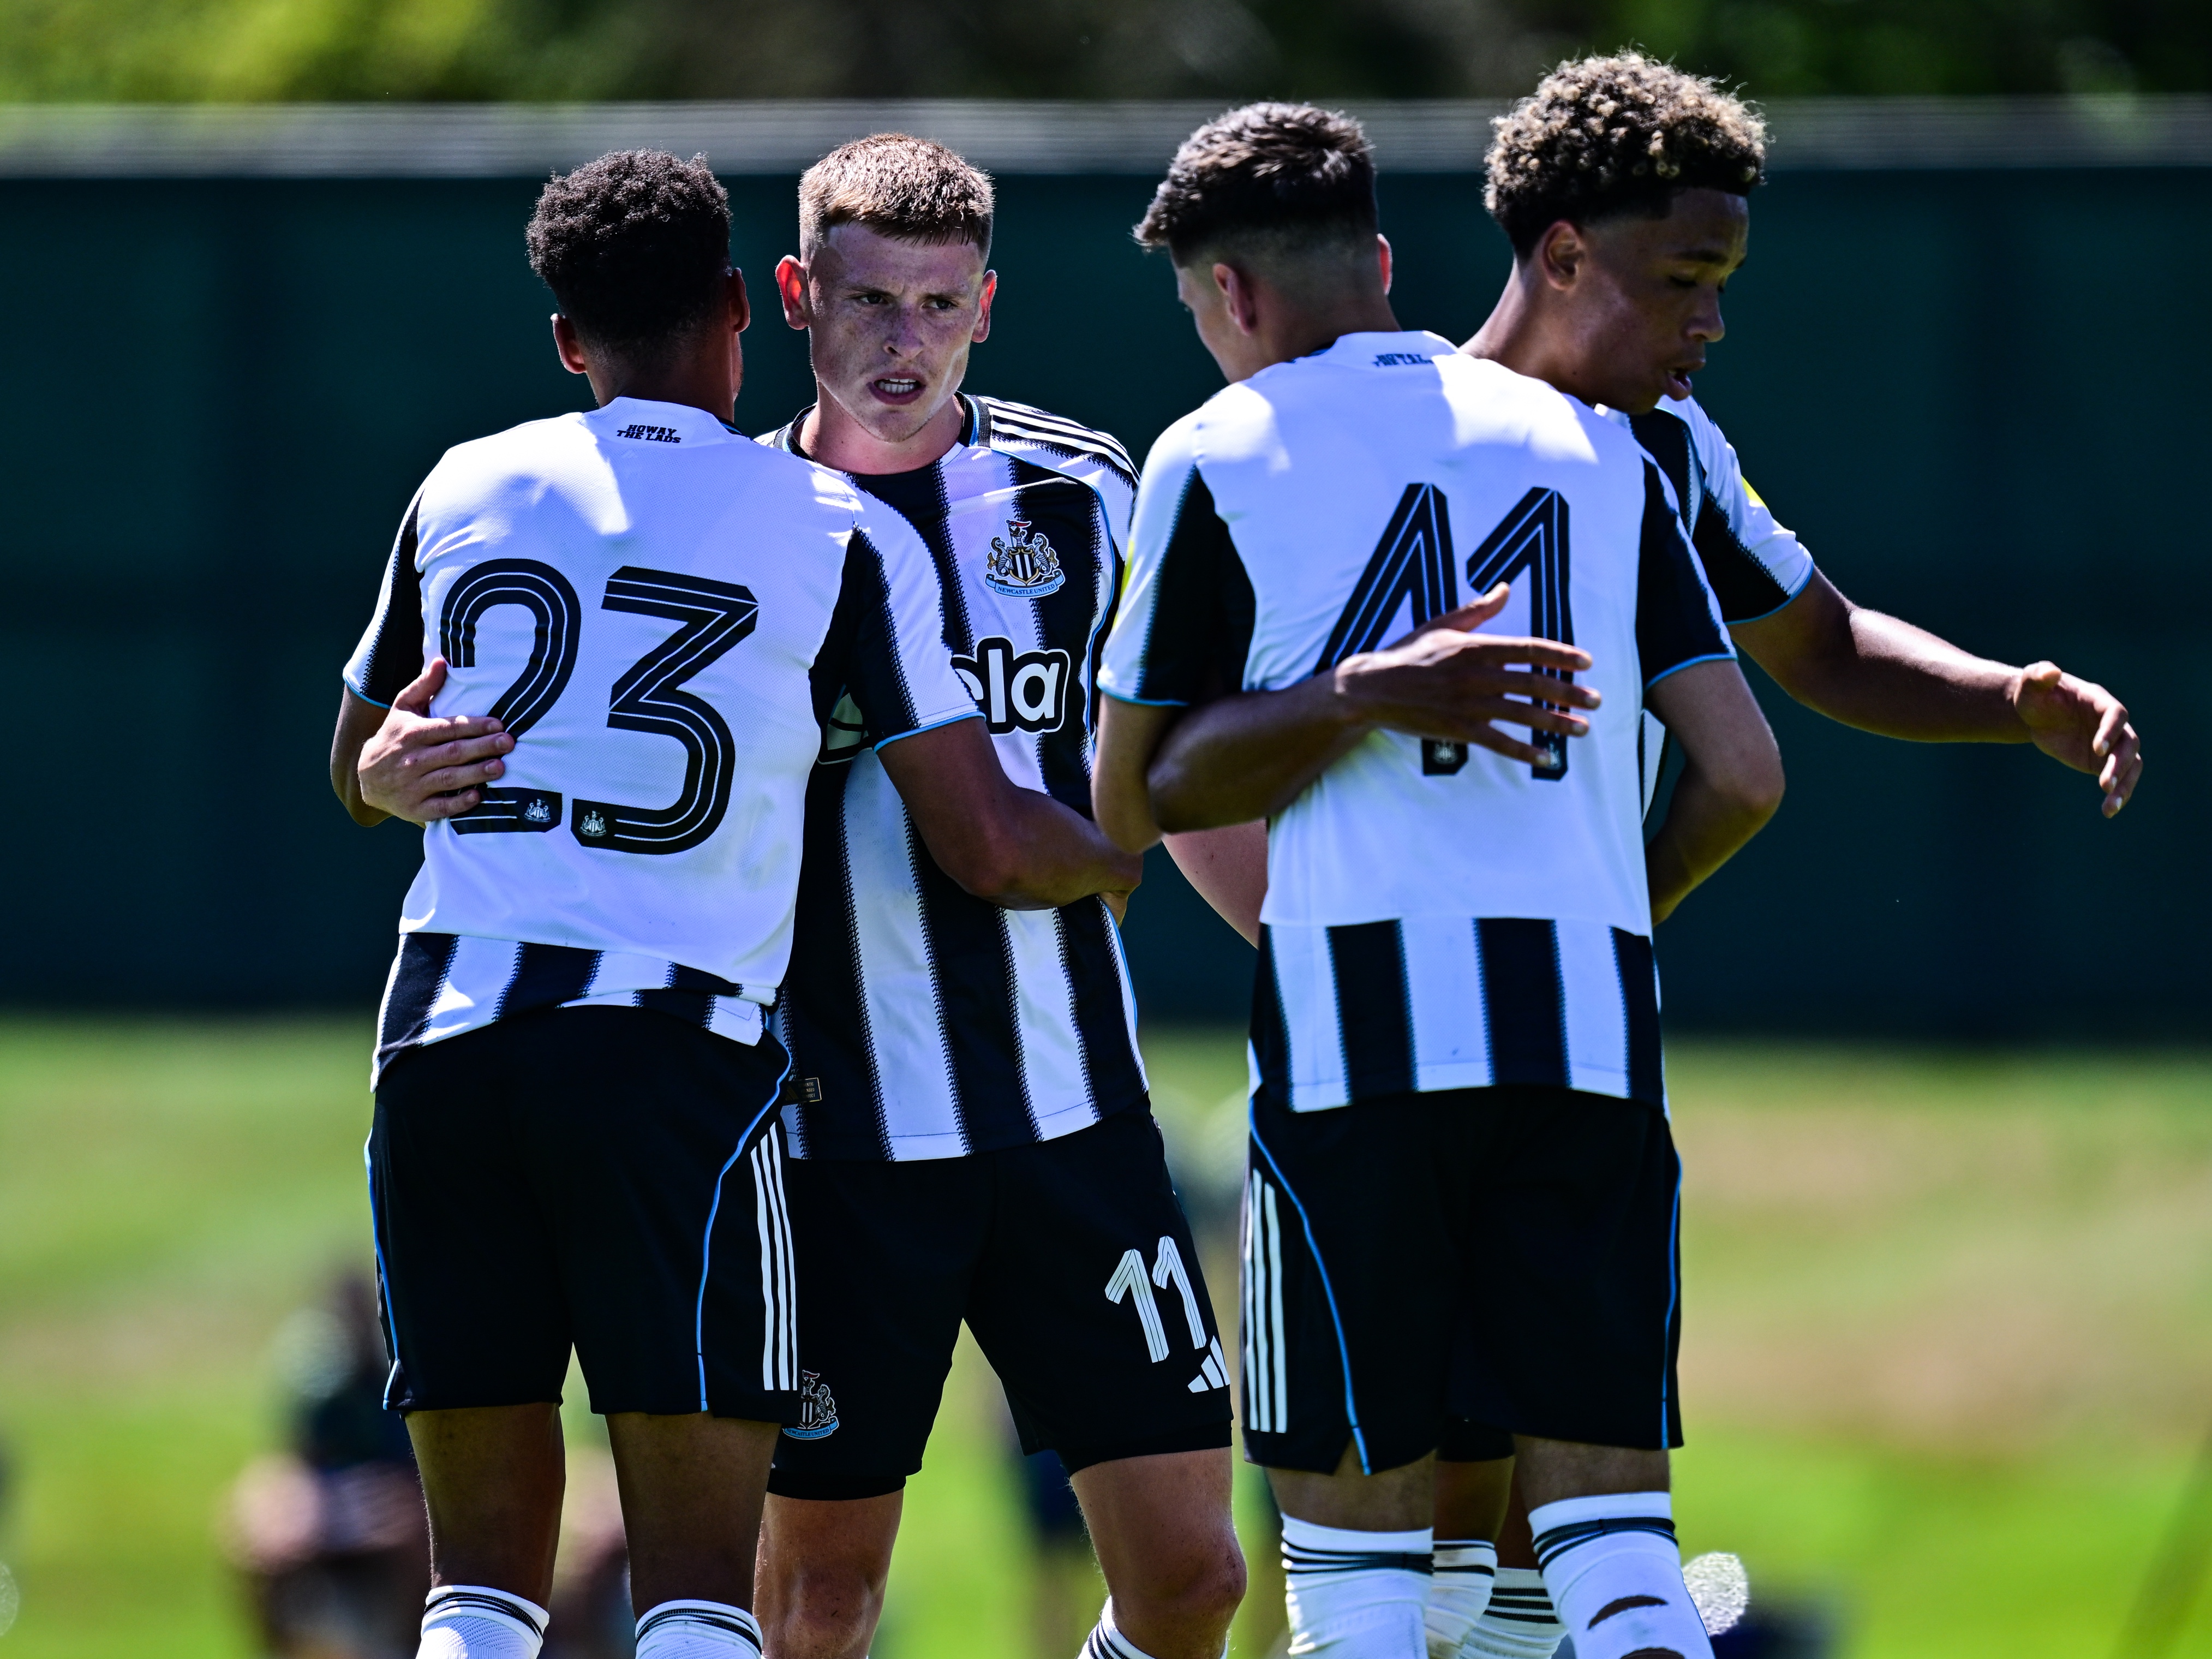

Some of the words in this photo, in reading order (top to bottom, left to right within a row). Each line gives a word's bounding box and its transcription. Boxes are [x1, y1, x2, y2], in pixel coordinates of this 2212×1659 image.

[617, 430, 644, 439] THE
[645, 434, 681, 443] LADS
[626, 425, 677, 436] HOWAY
[1035, 584, 1055, 593] UNITED
[439, 557, 759, 856] 23
[1104, 1236, 1207, 1363] 11
